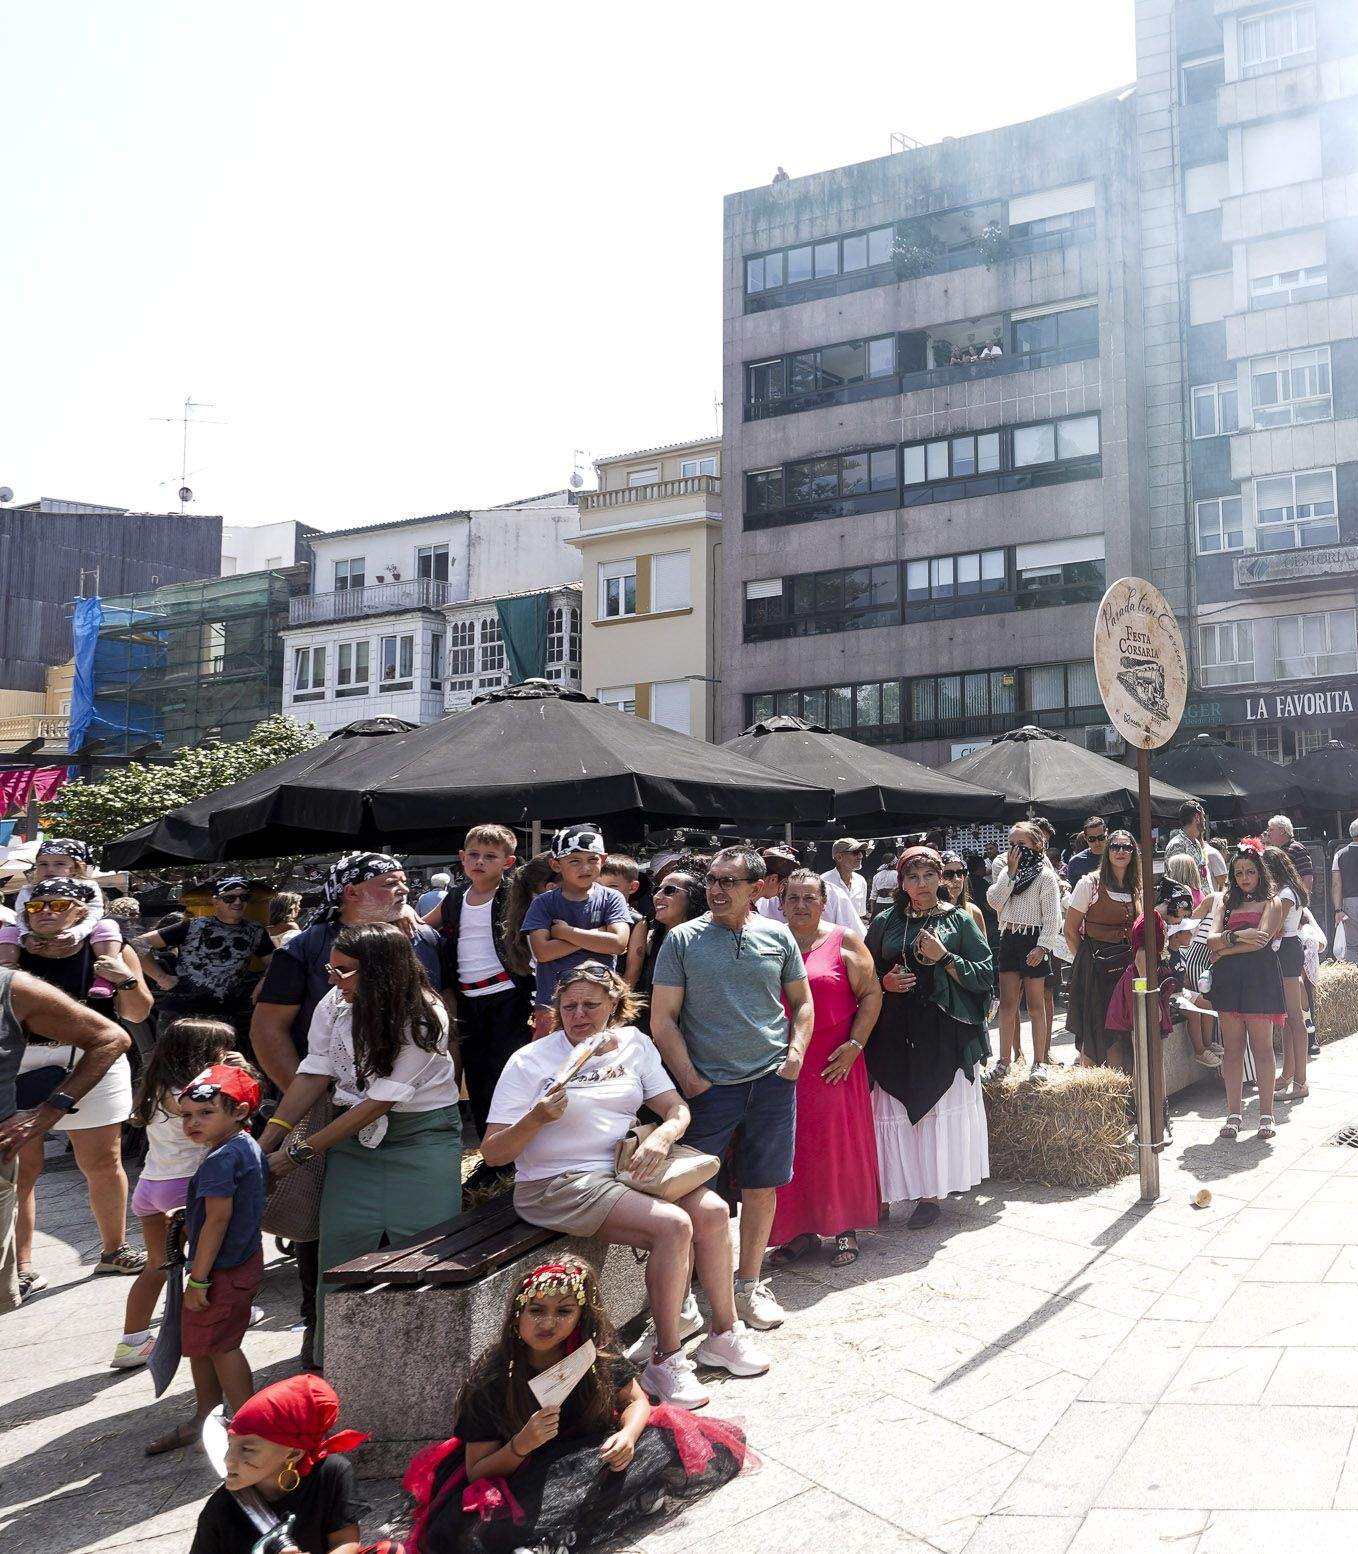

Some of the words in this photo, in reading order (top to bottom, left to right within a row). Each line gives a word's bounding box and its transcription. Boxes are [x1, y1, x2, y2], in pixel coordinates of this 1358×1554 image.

[1102, 588, 1136, 639] Parada
[1125, 625, 1151, 645] FESTA
[1119, 638, 1160, 659] CORSARIA
[1184, 702, 1222, 719] GER
[1246, 698, 1268, 720] LA
[1275, 690, 1354, 718] FAVORITA
